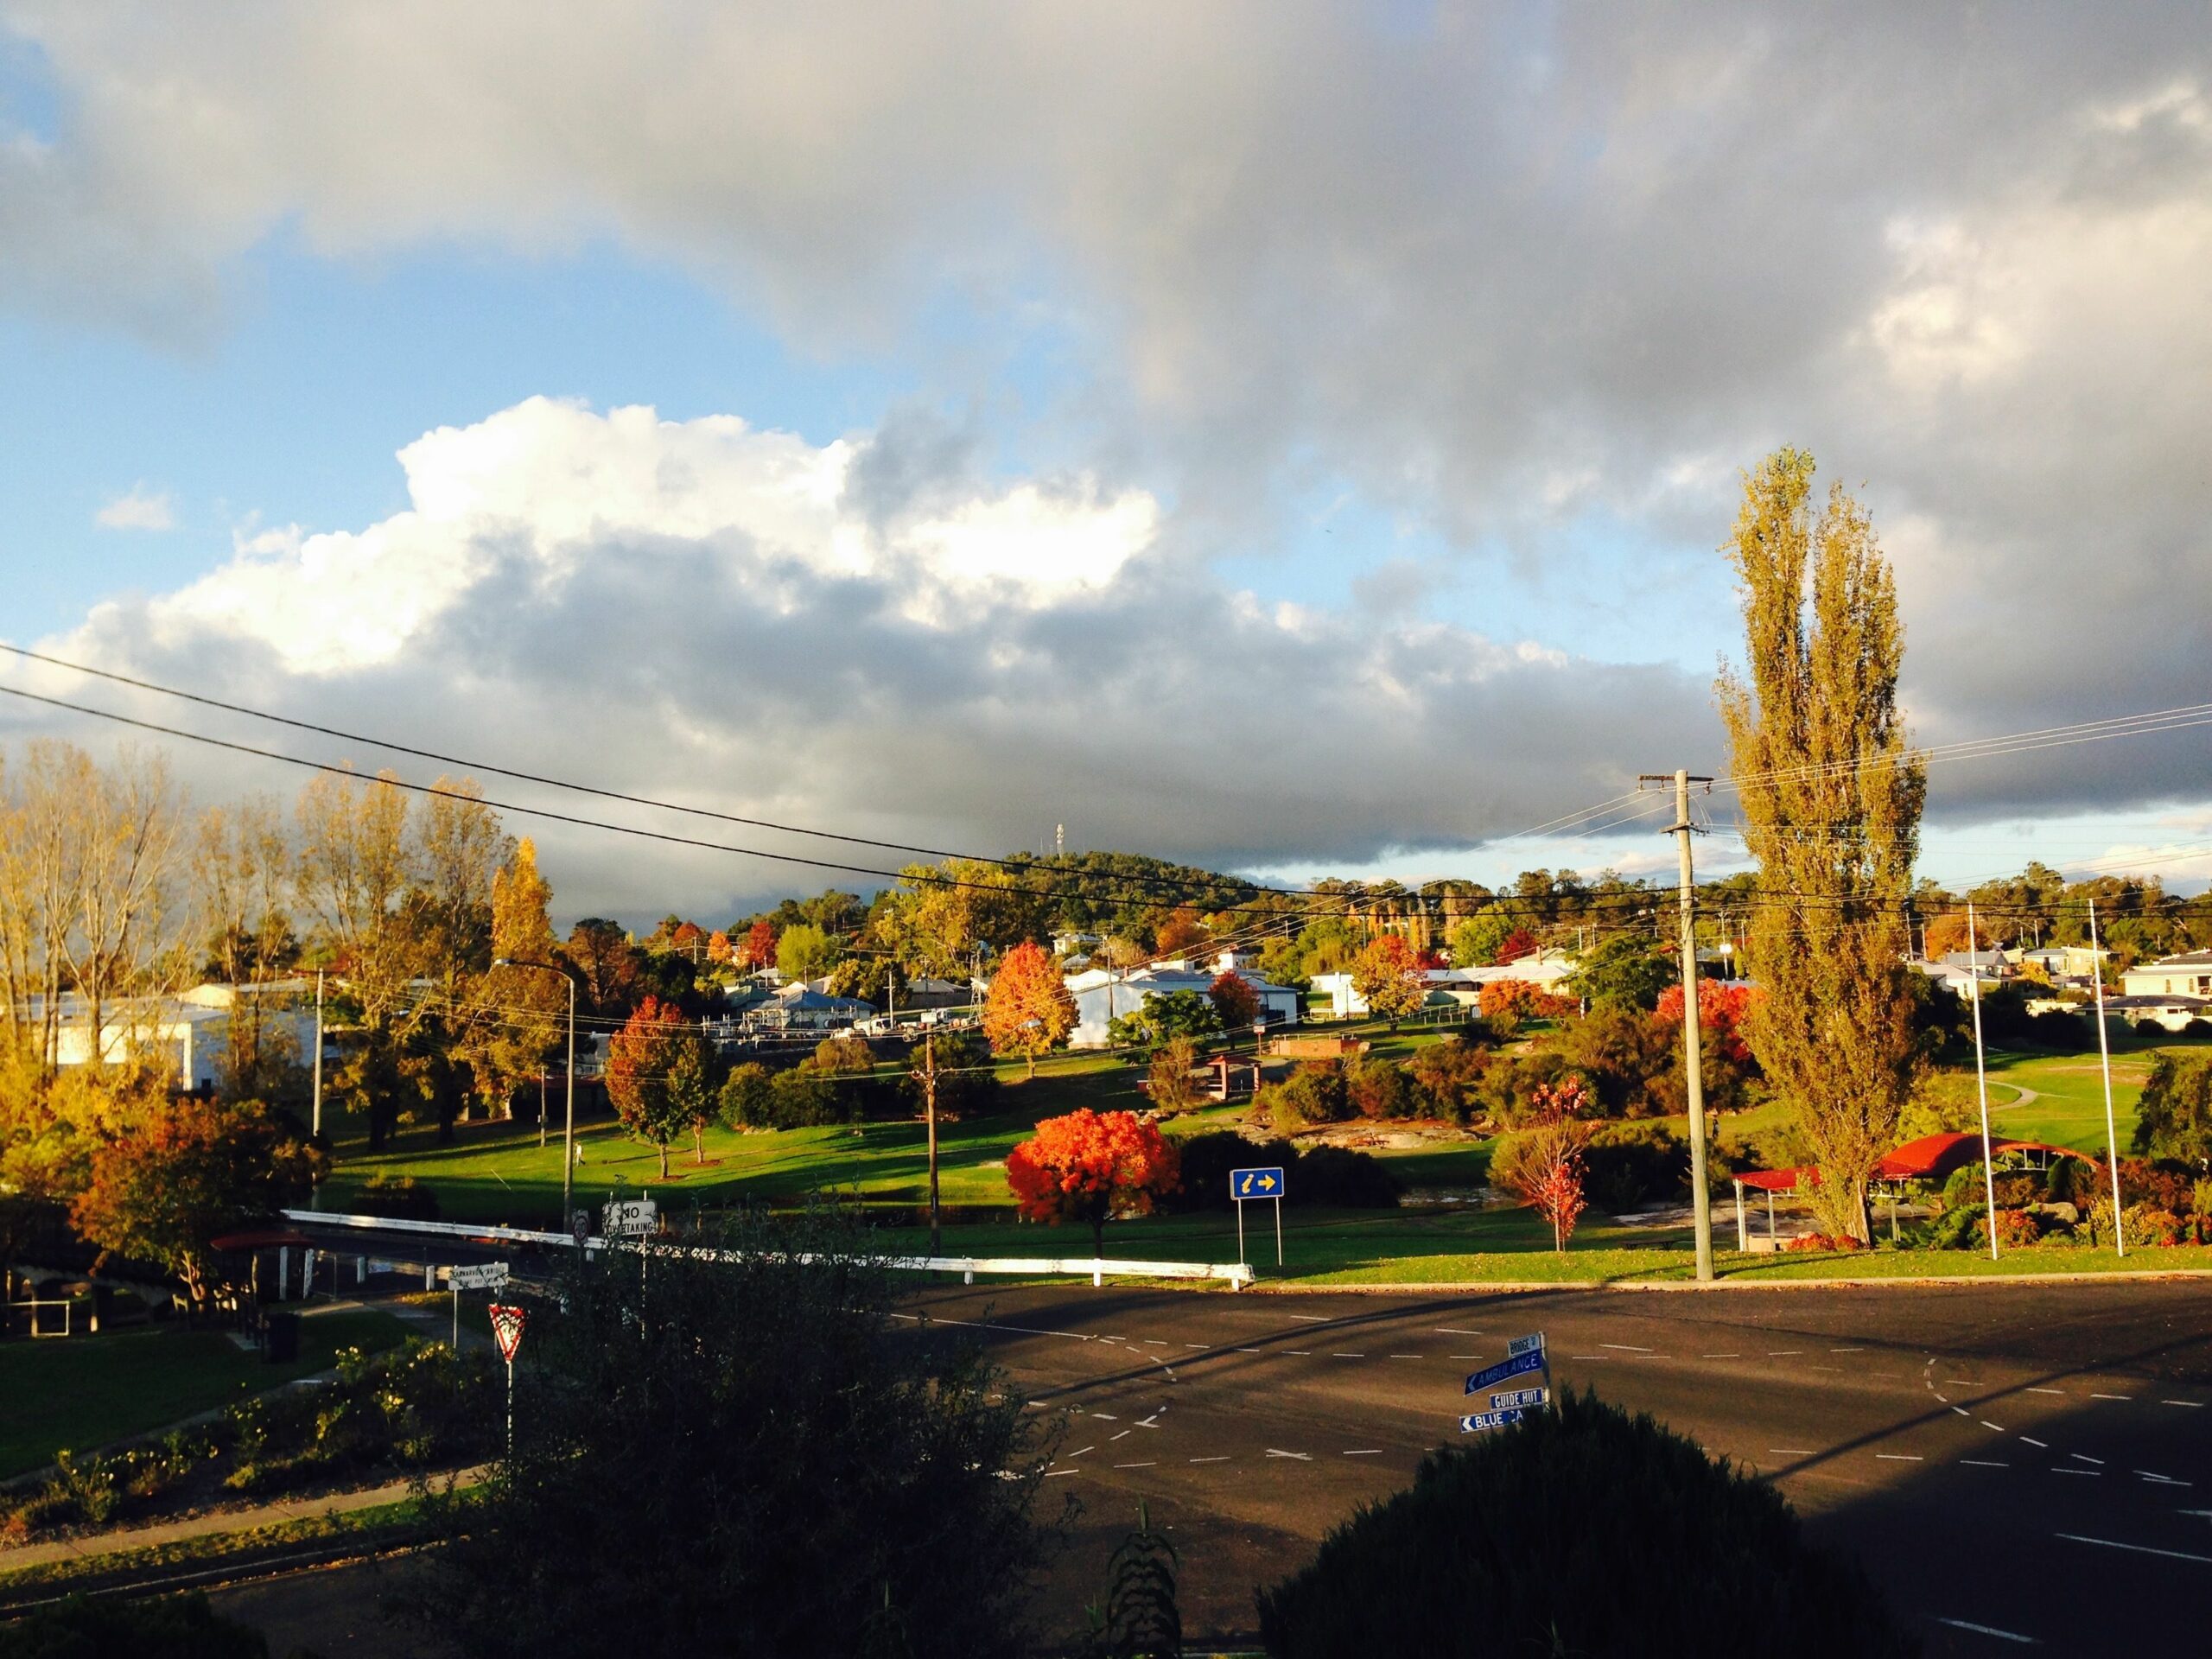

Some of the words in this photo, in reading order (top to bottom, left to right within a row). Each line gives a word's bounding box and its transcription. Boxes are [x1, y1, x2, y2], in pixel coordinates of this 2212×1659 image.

[621, 1206, 639, 1218] NO
[607, 1222, 652, 1235] OVRTAKING
[1510, 1338, 1529, 1354] BRIDGE
[1478, 1354, 1537, 1385] AMBULANCE
[1495, 1393, 1520, 1408] GUIDE
[1522, 1390, 1538, 1403] HUT
[1475, 1412, 1503, 1427] BLUE
